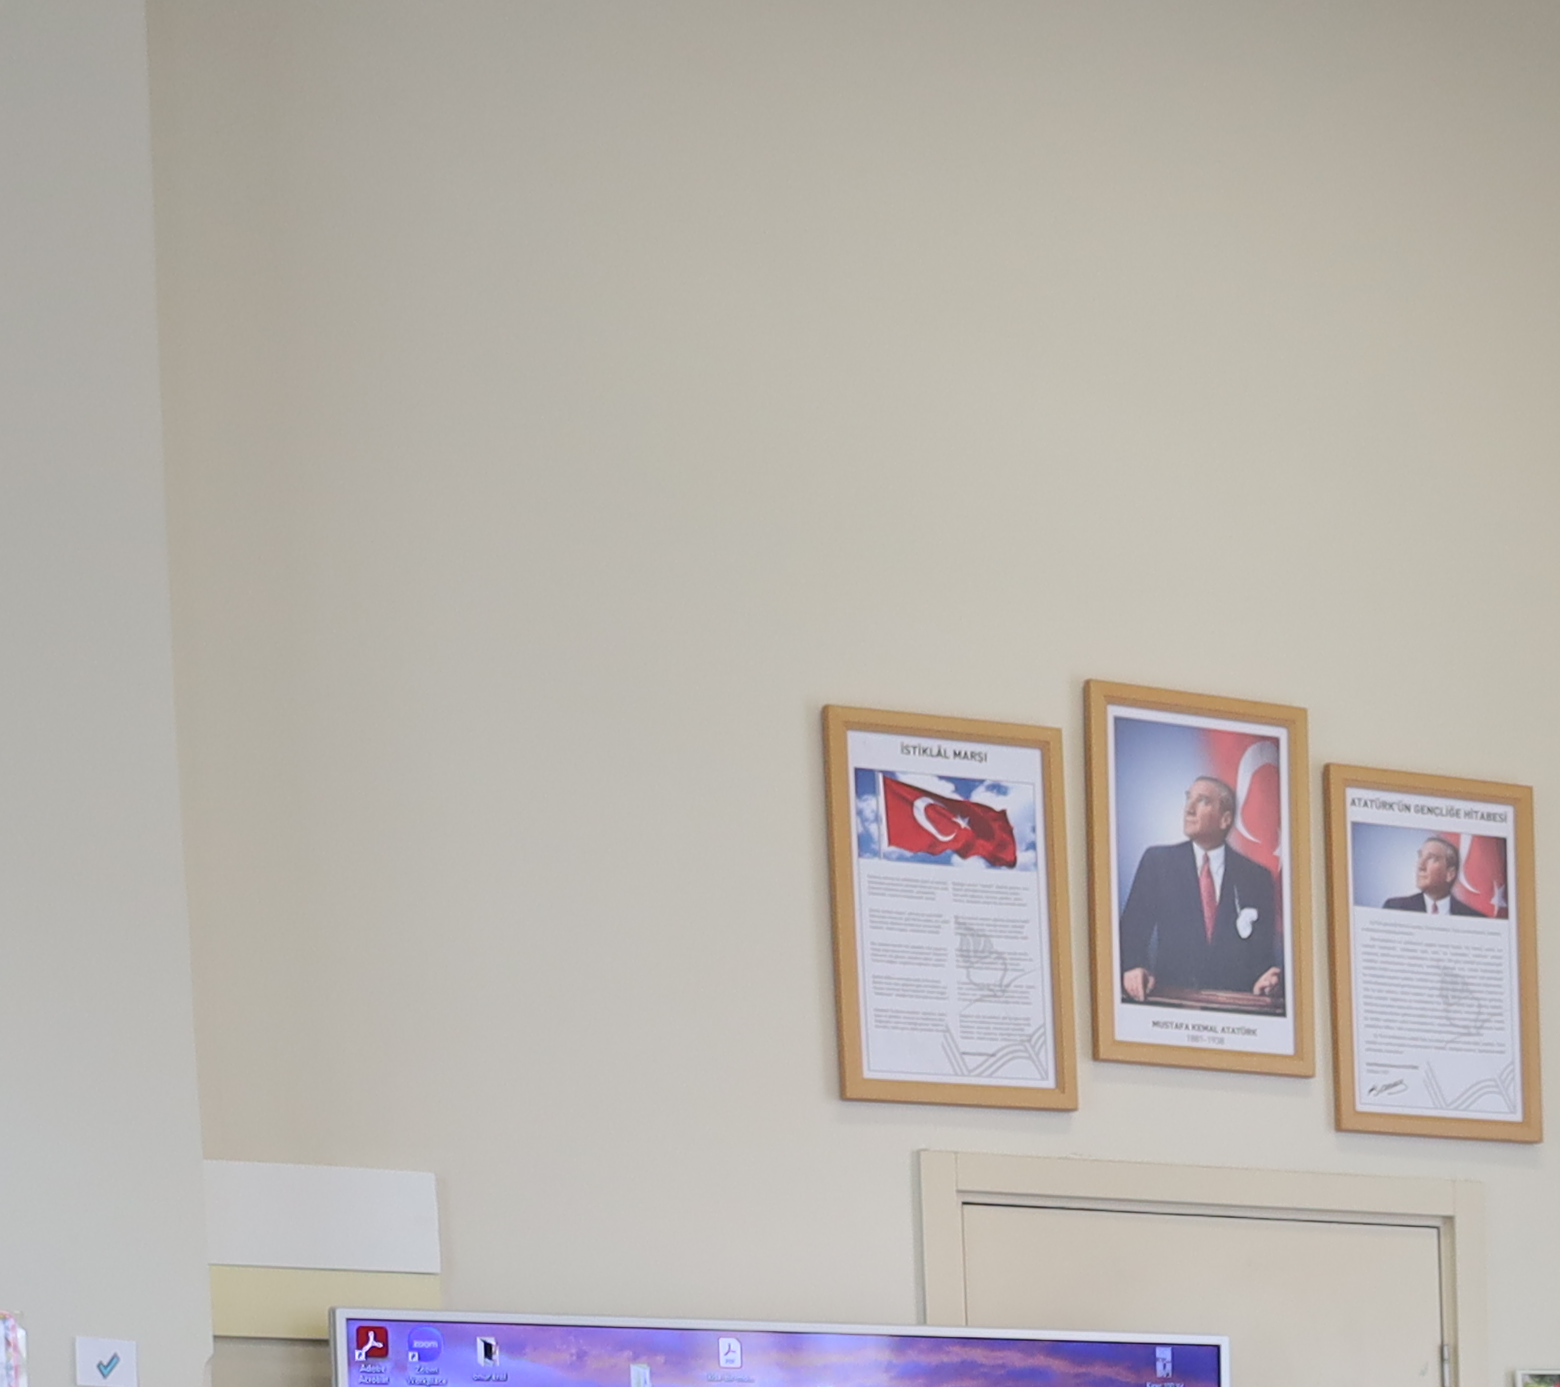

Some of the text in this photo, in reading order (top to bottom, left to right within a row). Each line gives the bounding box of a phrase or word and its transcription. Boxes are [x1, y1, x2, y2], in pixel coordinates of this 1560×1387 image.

[952, 748, 988, 763] MARŞI
[1350, 797, 1508, 823] ATATÜRK'ÜN GENÇLİĞE HİTABESİ
[1151, 1020, 1258, 1037] MUSTAFA KEMAL ATATÜRK
